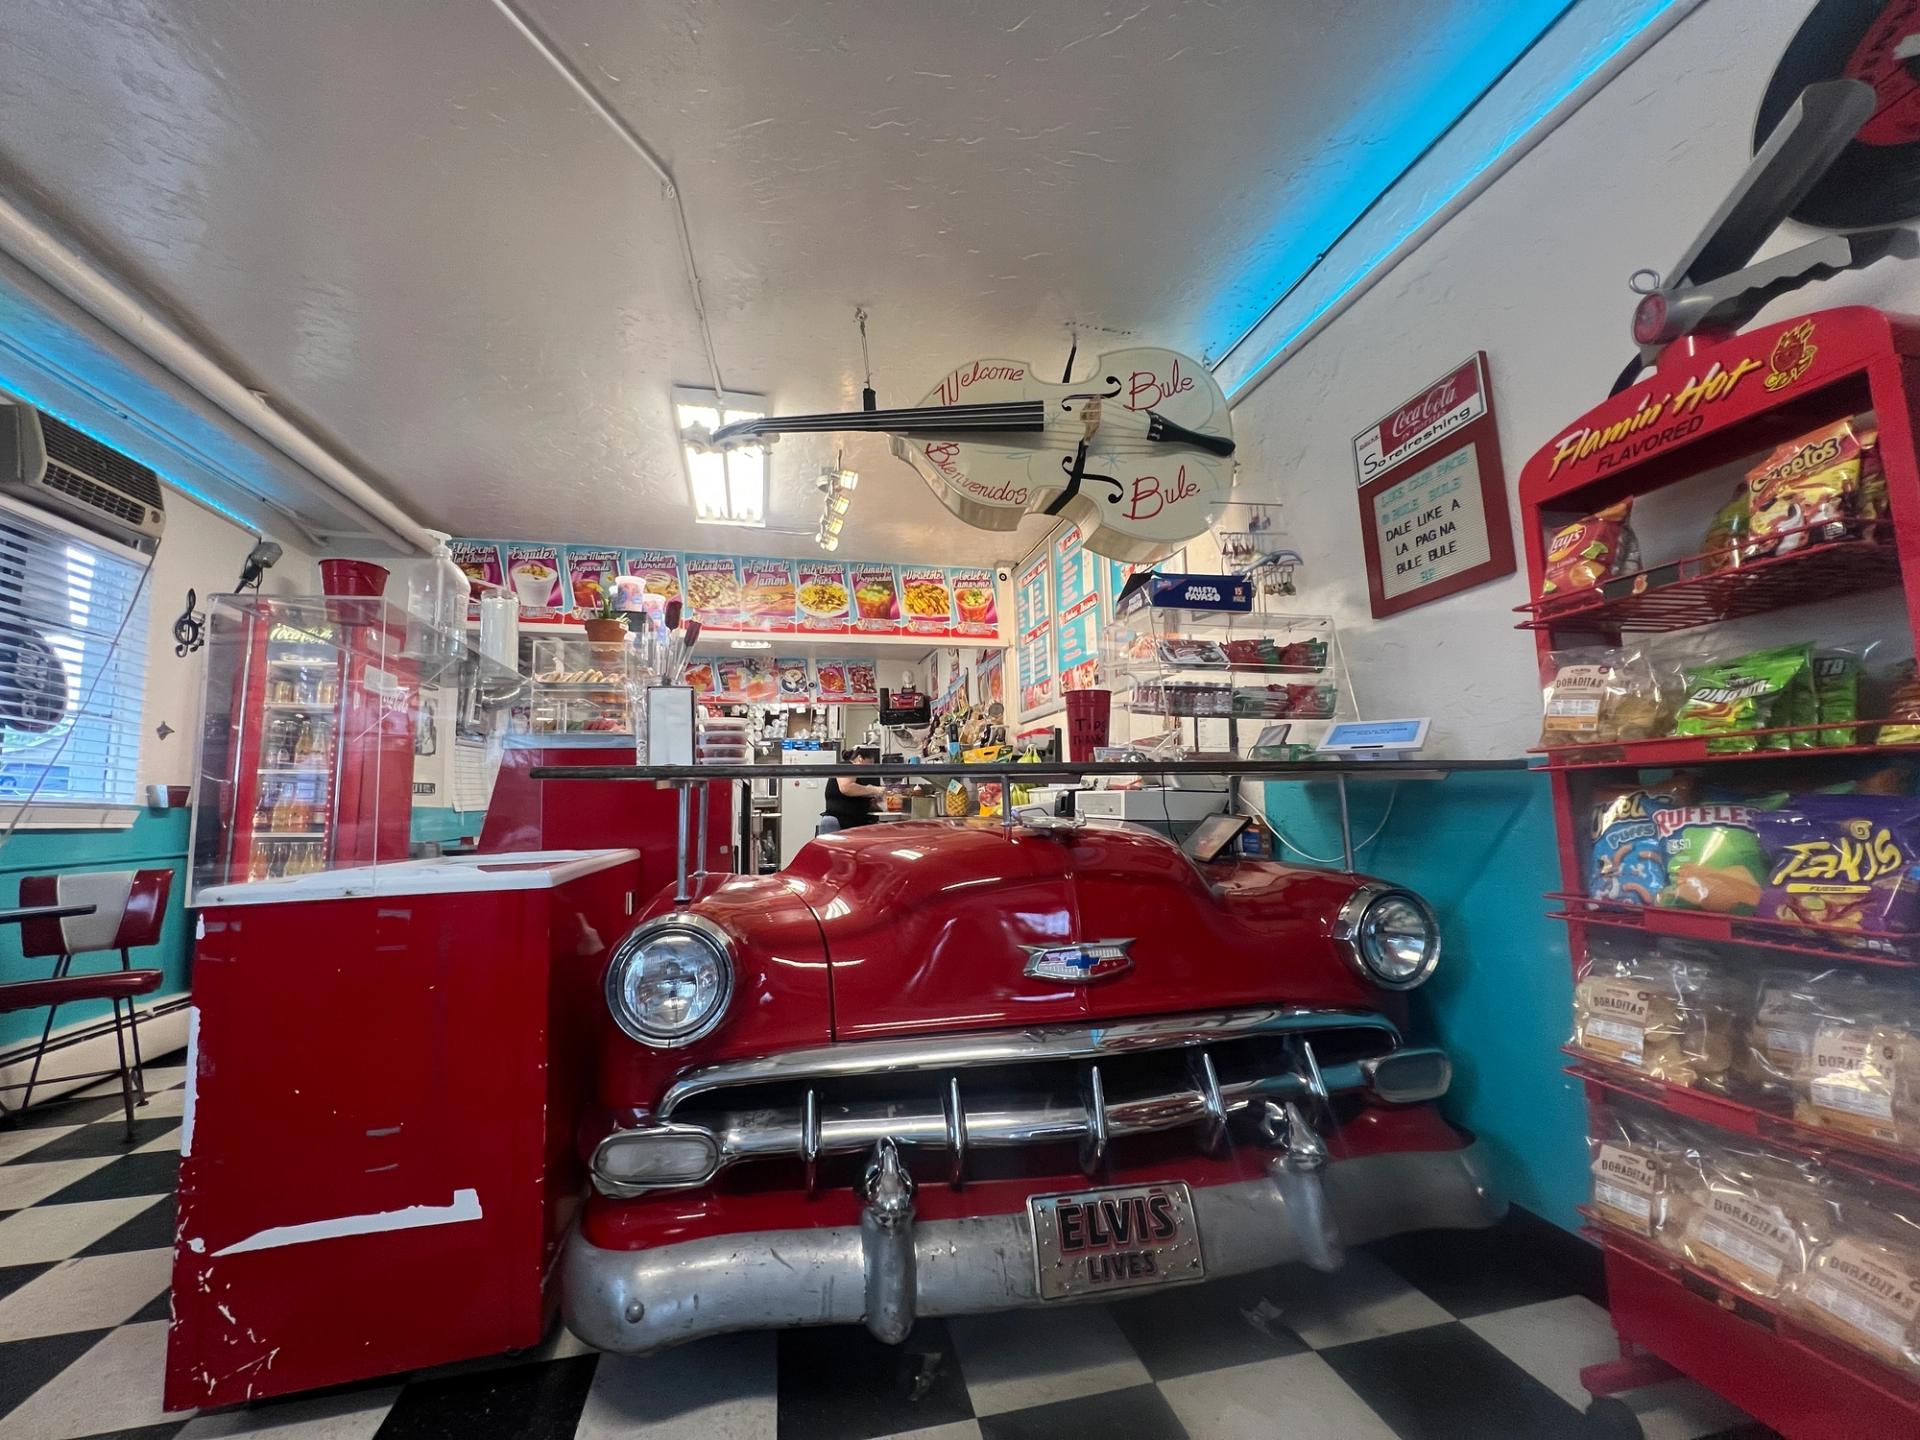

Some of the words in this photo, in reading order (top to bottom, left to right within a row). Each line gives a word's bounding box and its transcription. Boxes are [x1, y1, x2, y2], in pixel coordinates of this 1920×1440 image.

[933, 361, 1025, 406] Welcome
[1123, 359, 1195, 412] Bule
[1548, 392, 1672, 481] Flamin'
[1671, 357, 1764, 415] Hot
[1363, 452, 1387, 475] So
[1389, 406, 1471, 461] refreshing
[1595, 414, 1705, 473] FLAVORED
[925, 442, 1028, 505] Bienvenidos
[1123, 464, 1201, 520] Bule
[1385, 520, 1412, 542] DALE
[1417, 506, 1442, 527] LIKE
[1451, 498, 1461, 512] A
[510, 546, 558, 562] Esquites
[1395, 543, 1409, 557] LA
[1396, 555, 1423, 575] BULE
[1428, 540, 1457, 561] BULE
[1185, 592, 1221, 602] PAYASO
[1188, 586, 1218, 594] PALETA
[1556, 676, 1605, 689] DORADITAS
[1606, 823, 1656, 850] PUFFS
[1652, 805, 1758, 840] RUFFLES
[1593, 996, 1646, 1016] DORADITAS
[1817, 1053, 1893, 1081] DORAS
[1601, 1159, 1653, 1187] DORADITAS
[1056, 1195, 1177, 1252] ELVIS
[1714, 1198, 1788, 1244] DORADITAS
[1085, 1252, 1158, 1283] LIVES
